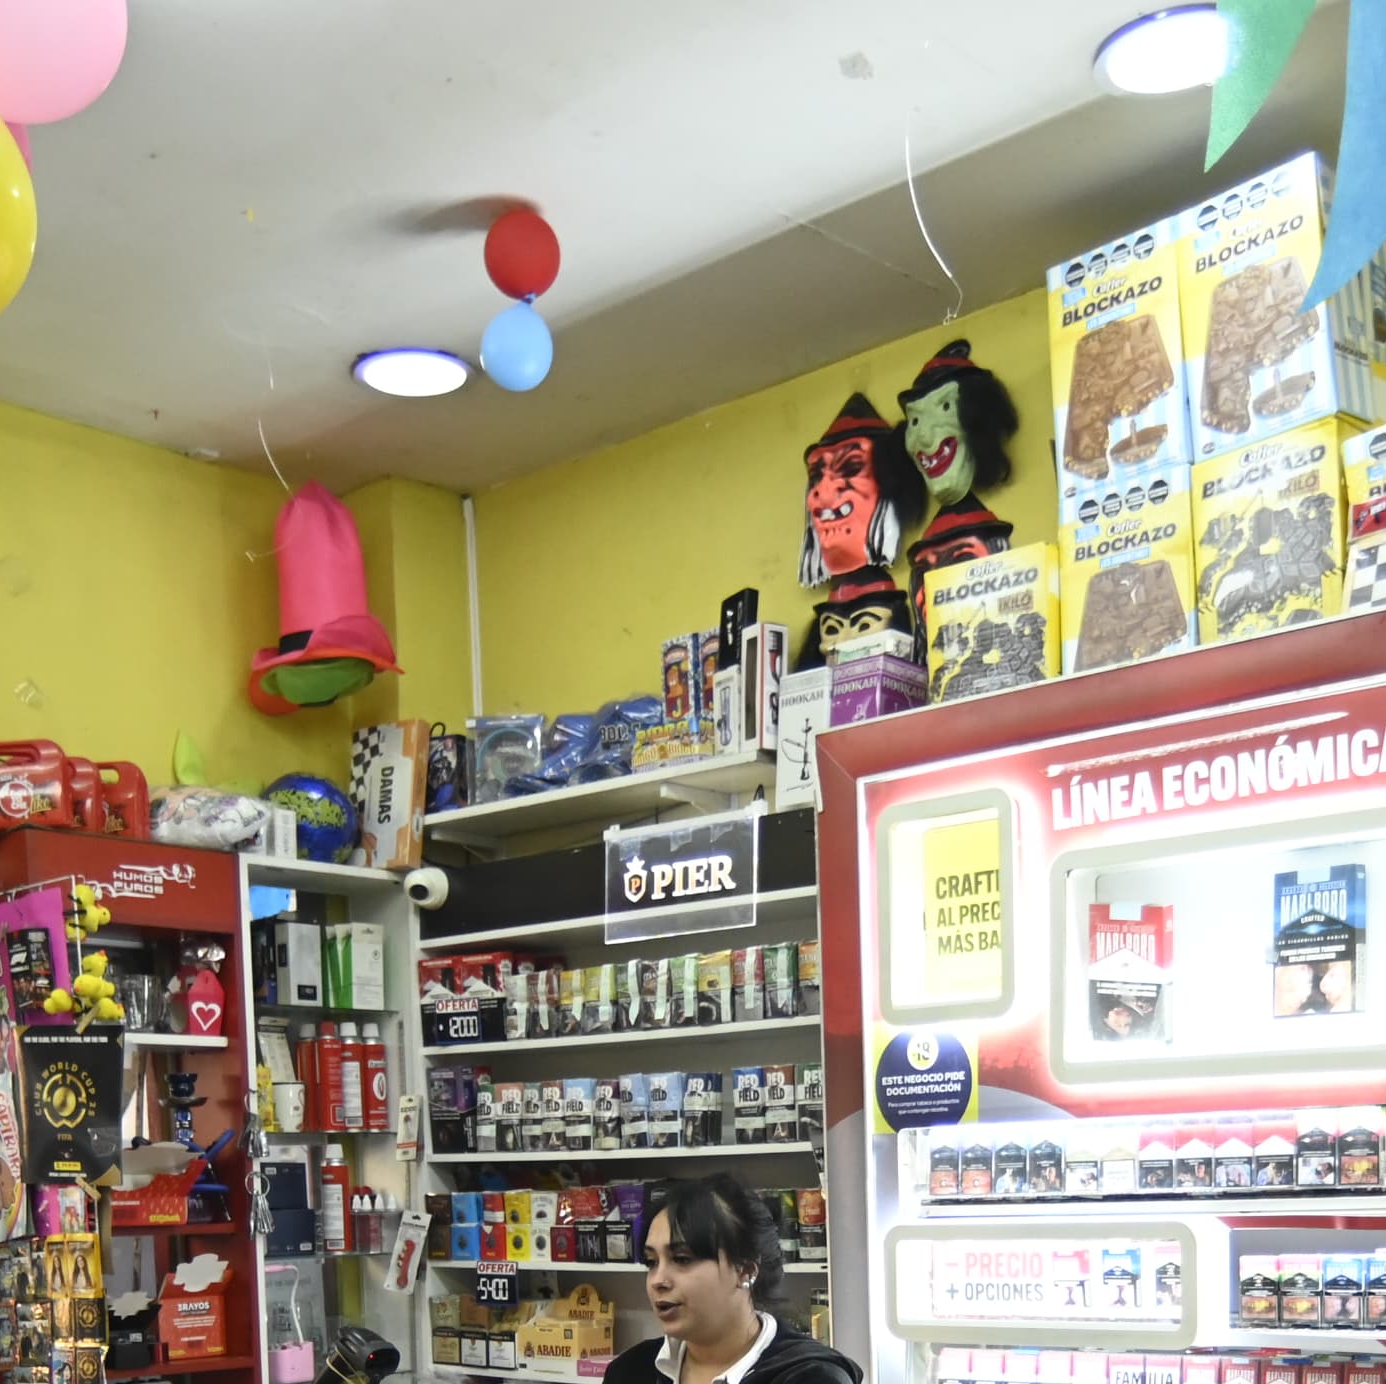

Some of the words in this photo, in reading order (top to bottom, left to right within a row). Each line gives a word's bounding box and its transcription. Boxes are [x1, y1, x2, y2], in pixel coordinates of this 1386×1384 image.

[1195, 214, 1304, 273] BLOCKAZO
[1062, 276, 1163, 328] BLOCKAZO
[1074, 523, 1177, 562] BLOCKAZO
[933, 567, 1038, 606] BLOCKAZO
[834, 678, 878, 696] HOOKAH
[780, 689, 824, 709] HOOKAH
[378, 765, 394, 825] DAMAS
[1052, 770, 1158, 831] LÍNEA
[113, 871, 163, 884] HUMOS
[651, 855, 736, 900] PIER
[936, 869, 1000, 899] CRAFT
[113, 881, 164, 895] PUROS
[937, 908, 956, 927] AL
[1280, 889, 1347, 929] MARLBORO
[938, 930, 974, 956] MÁS
[436, 1000, 478, 1011] OFERTA
[882, 1074, 903, 1086] ESTE
[904, 1071, 943, 1084] NEGOCIO
[944, 1070, 965, 1081] PIDE
[35, 1081, 44, 1116] CLUB
[42, 1061, 78, 1081] WORLD
[81, 1071, 96, 1096] CUP
[738, 1088, 760, 1102] FIELD
[886, 1081, 961, 1096] DOCUMENTACIÓN
[478, 1264, 516, 1274] OFERTA
[965, 1252, 1043, 1279] PRECIO
[965, 1283, 1044, 1302] OPCIONES
[568, 1310, 595, 1320] ABADIE
[537, 1343, 572, 1357] ABADIE
